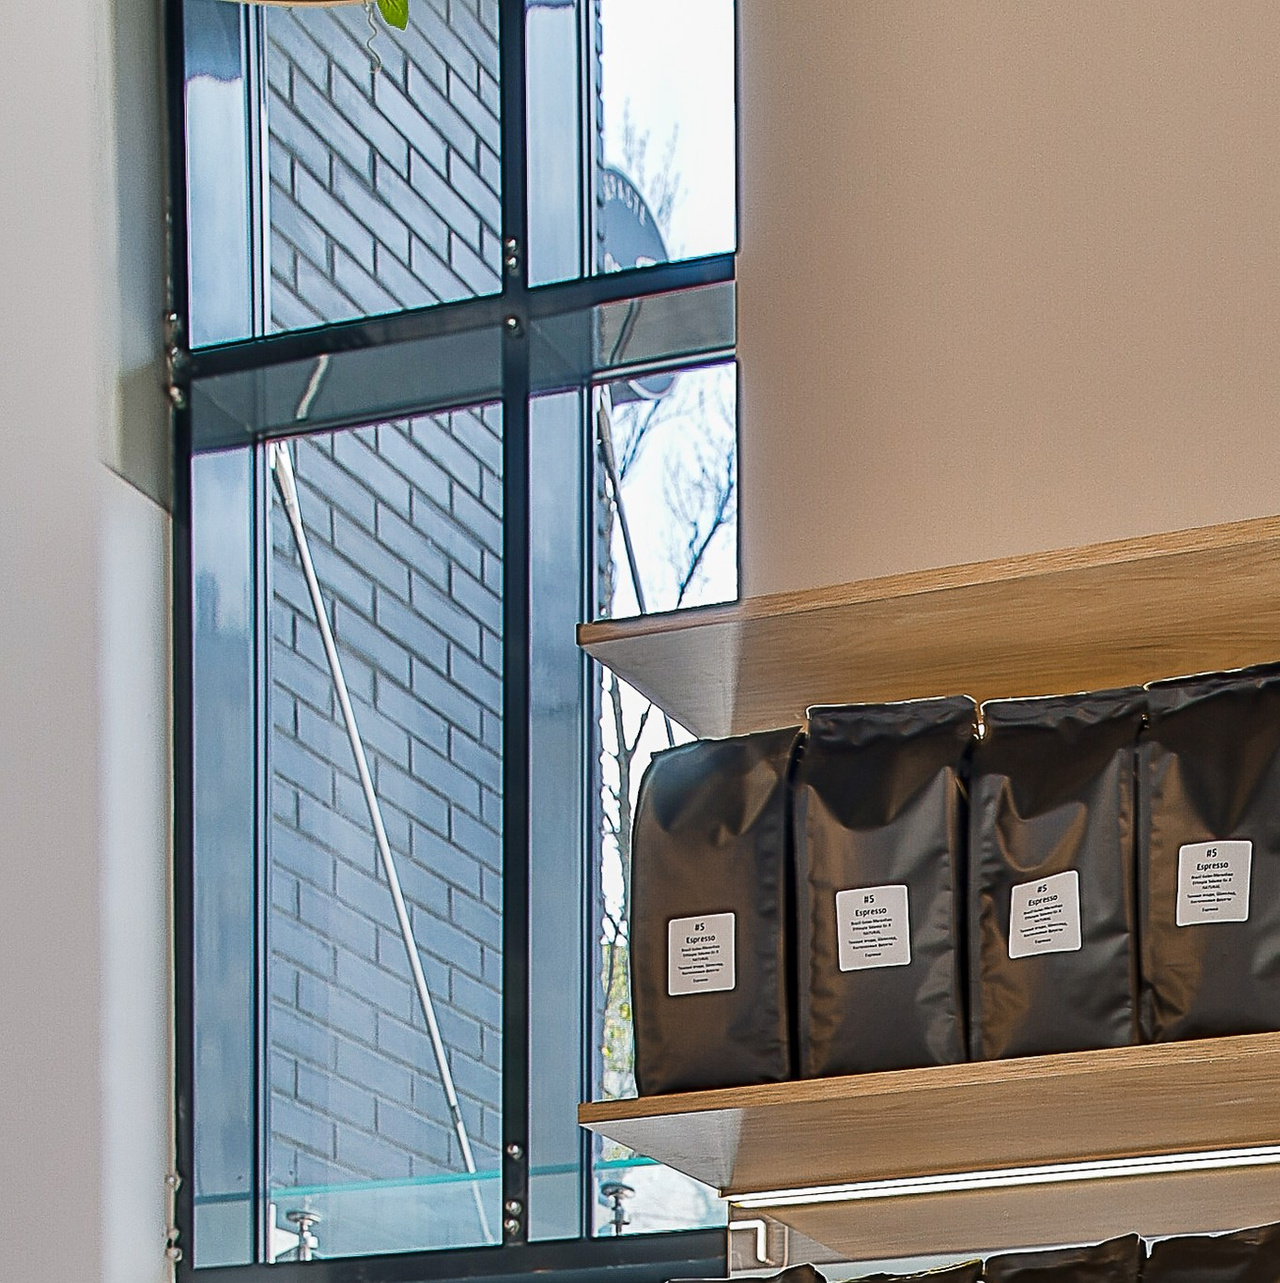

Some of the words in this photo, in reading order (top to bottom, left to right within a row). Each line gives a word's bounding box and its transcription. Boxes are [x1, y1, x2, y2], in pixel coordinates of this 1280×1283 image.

[1196, 861, 1229, 871] Espresso
[1028, 894, 1058, 906] Espresso
[855, 907, 887, 917] Espresso
[686, 935, 716, 944] Espresso
